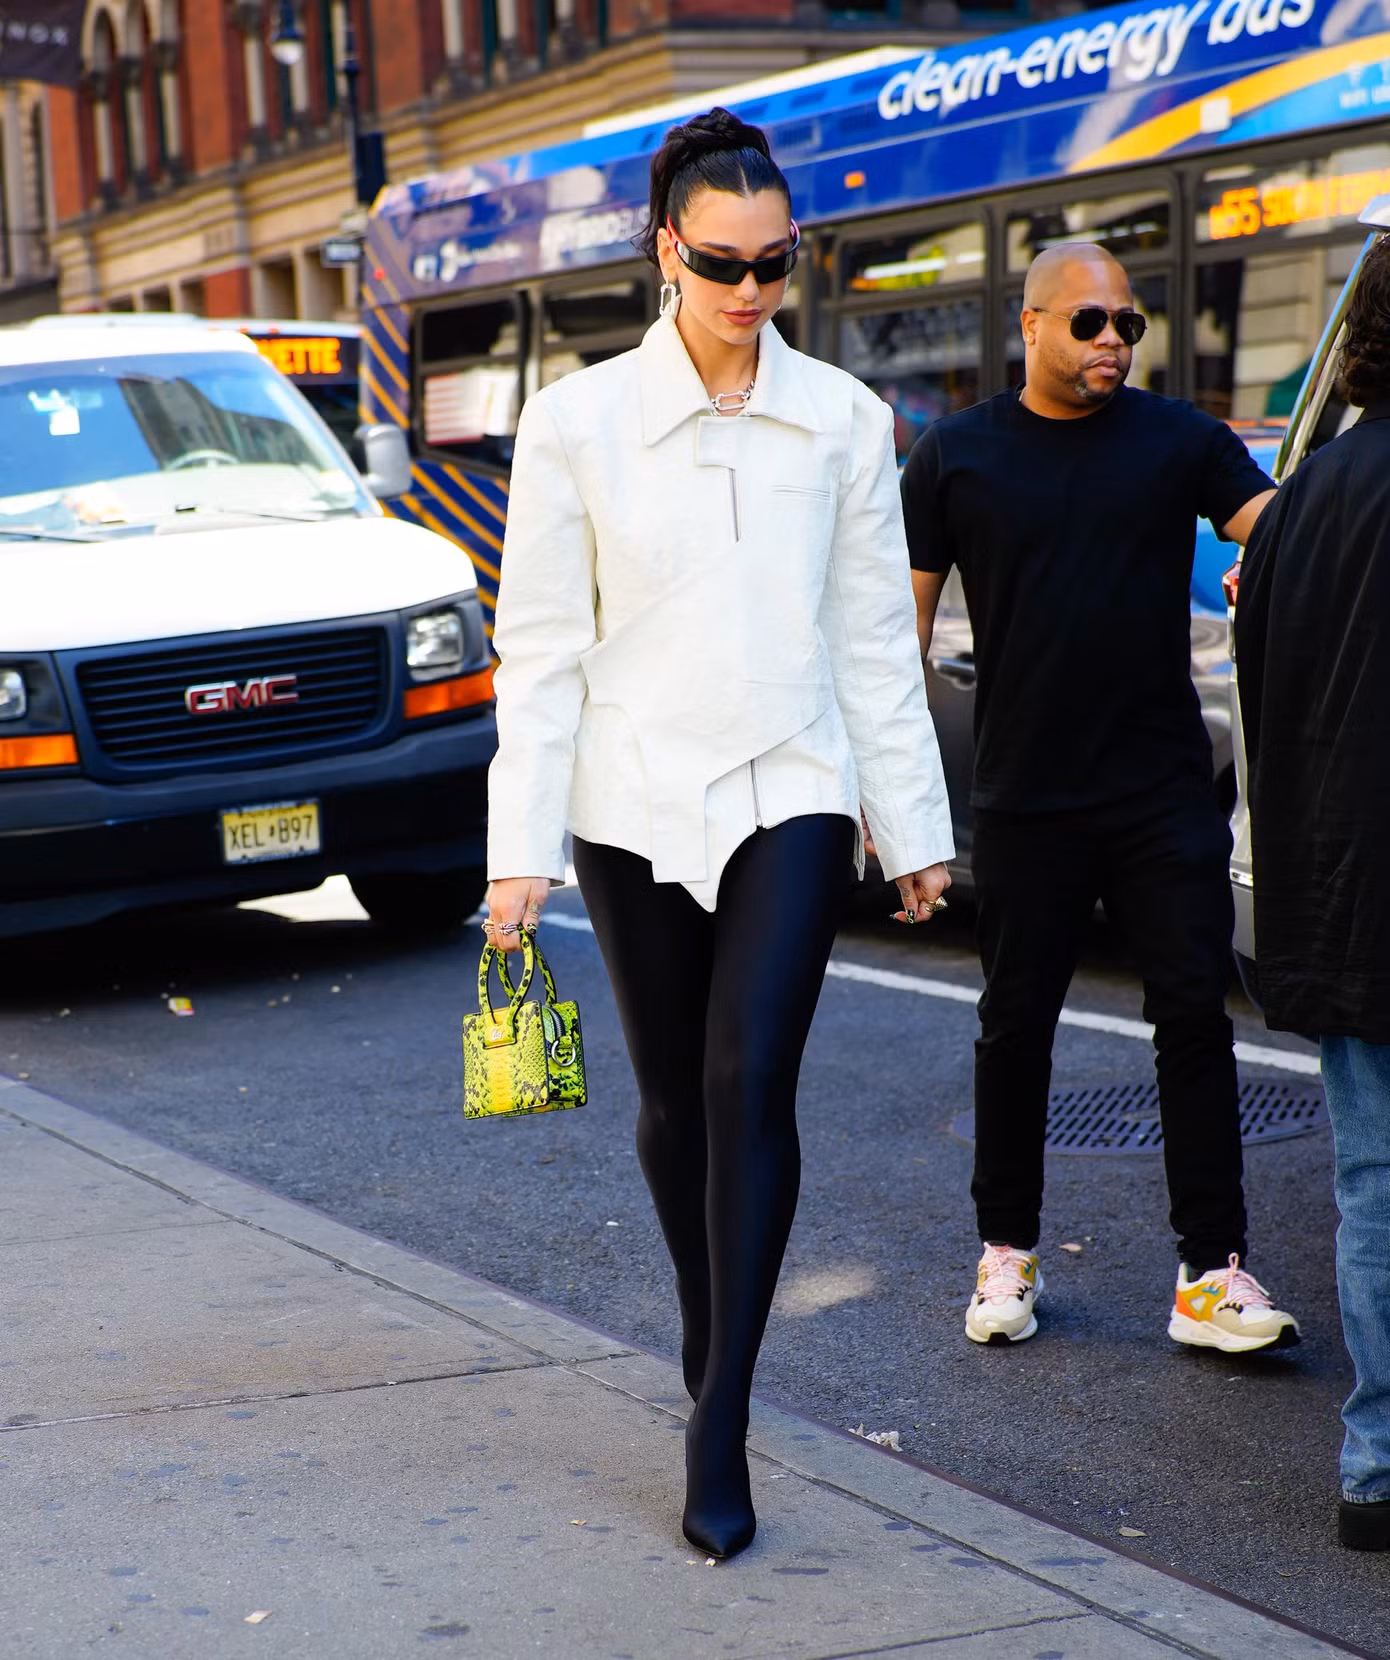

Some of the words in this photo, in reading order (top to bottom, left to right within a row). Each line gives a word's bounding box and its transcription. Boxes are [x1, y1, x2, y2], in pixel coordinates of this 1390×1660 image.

[877, 1, 1211, 120] clean-energy
[1207, 0, 1315, 45] bus
[185, 673, 298, 714] GMC
